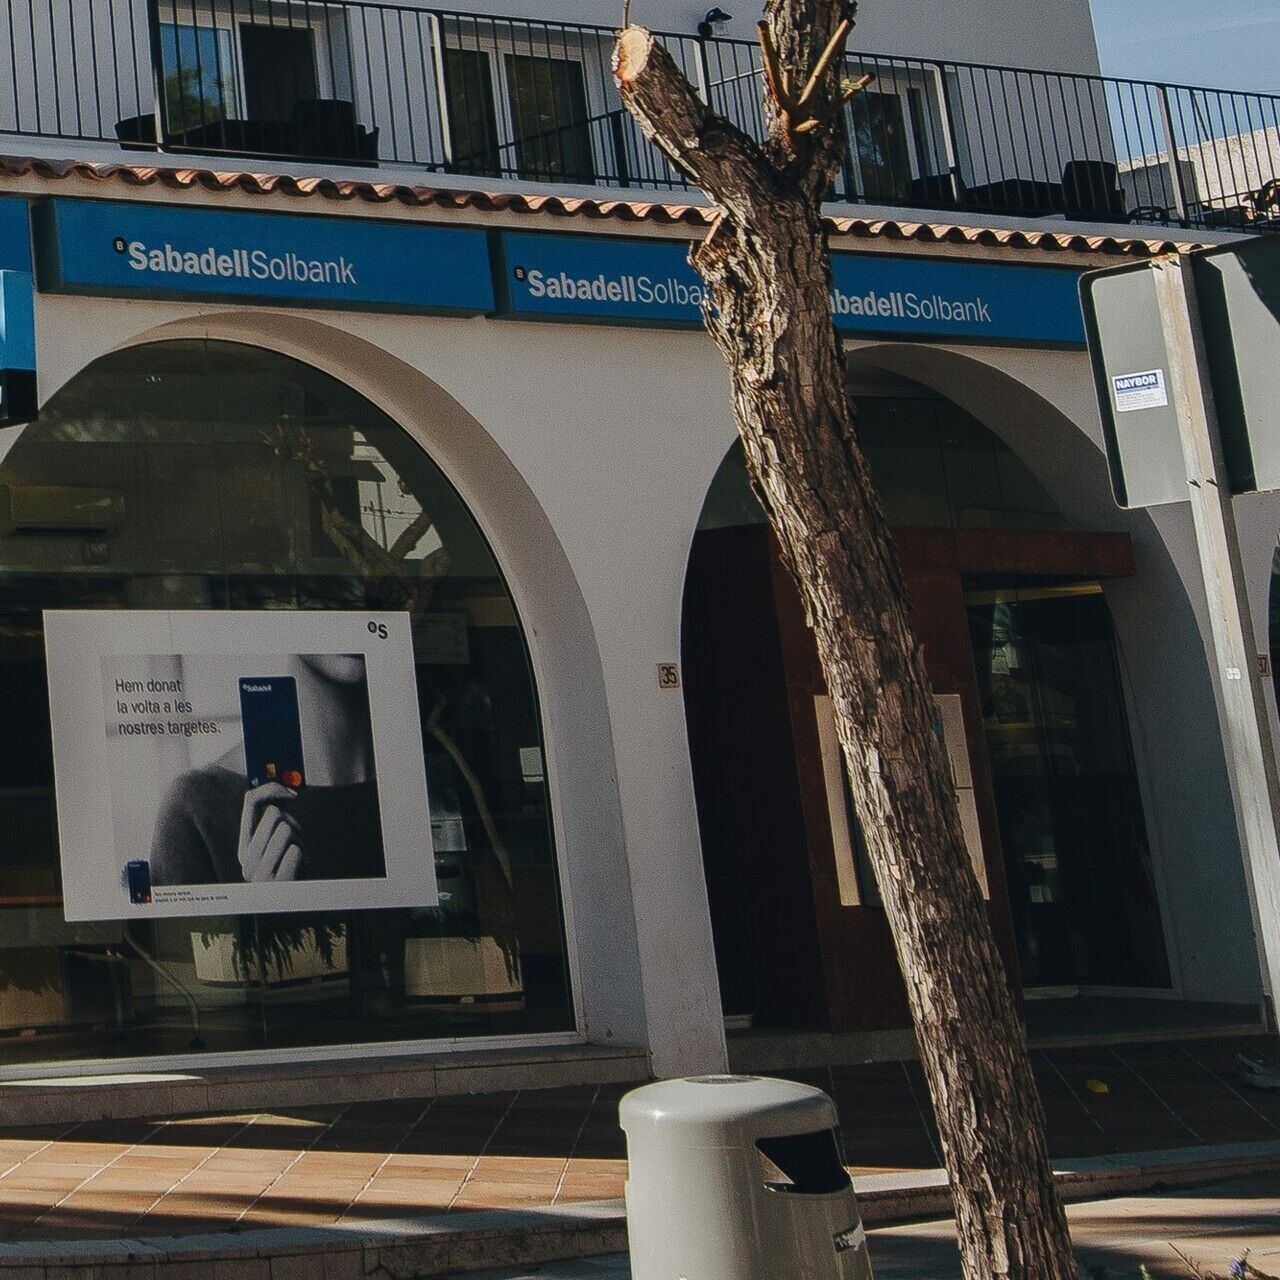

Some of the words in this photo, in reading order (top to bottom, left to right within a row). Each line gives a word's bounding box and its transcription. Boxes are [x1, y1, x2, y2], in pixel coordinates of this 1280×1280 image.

[128, 241, 358, 285] SabadellSolbank
[527, 270, 708, 306] SabadellSolba
[829, 289, 992, 323] badellSolbank
[1116, 374, 1157, 389] NAYBOR
[661, 666, 677, 684] 35
[115, 679, 144, 693] Hem
[146, 678, 182, 693] donat
[116, 700, 128, 714] la
[131, 699, 161, 715] volta
[163, 702, 172, 713] a
[174, 699, 193, 713] les
[118, 721, 165, 736] nostres
[167, 721, 221, 737] targetes.
